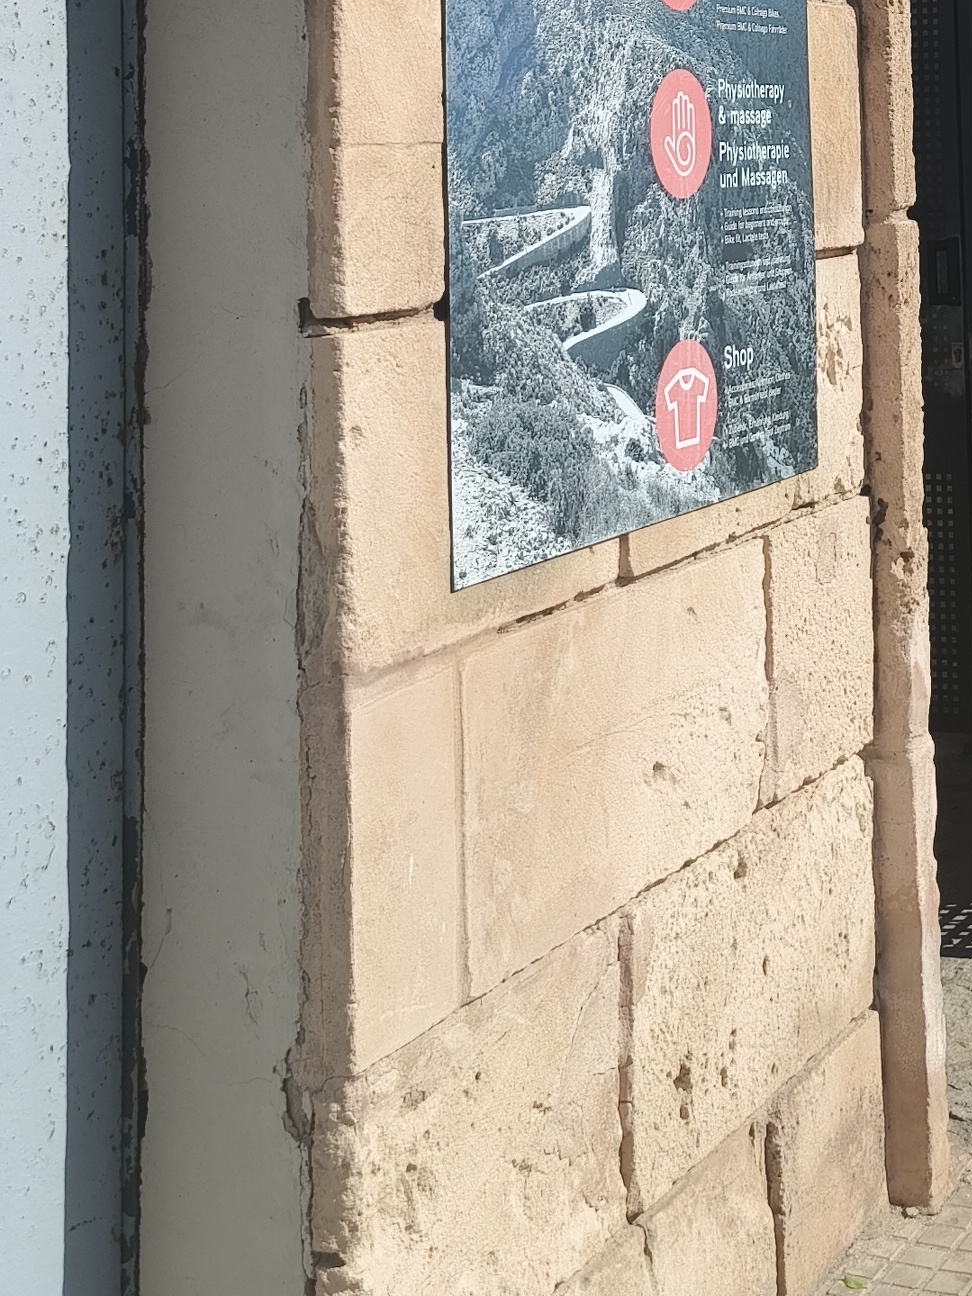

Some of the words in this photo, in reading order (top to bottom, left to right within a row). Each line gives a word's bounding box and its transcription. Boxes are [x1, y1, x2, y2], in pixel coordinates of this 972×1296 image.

[718, 78, 785, 104] Physiotherapy
[718, 105, 726, 125] &
[731, 109, 773, 128] massage
[719, 139, 790, 166] Physiotherapie
[720, 167, 738, 188] und
[741, 167, 788, 189] Massagen
[724, 344, 754, 371] Shop
